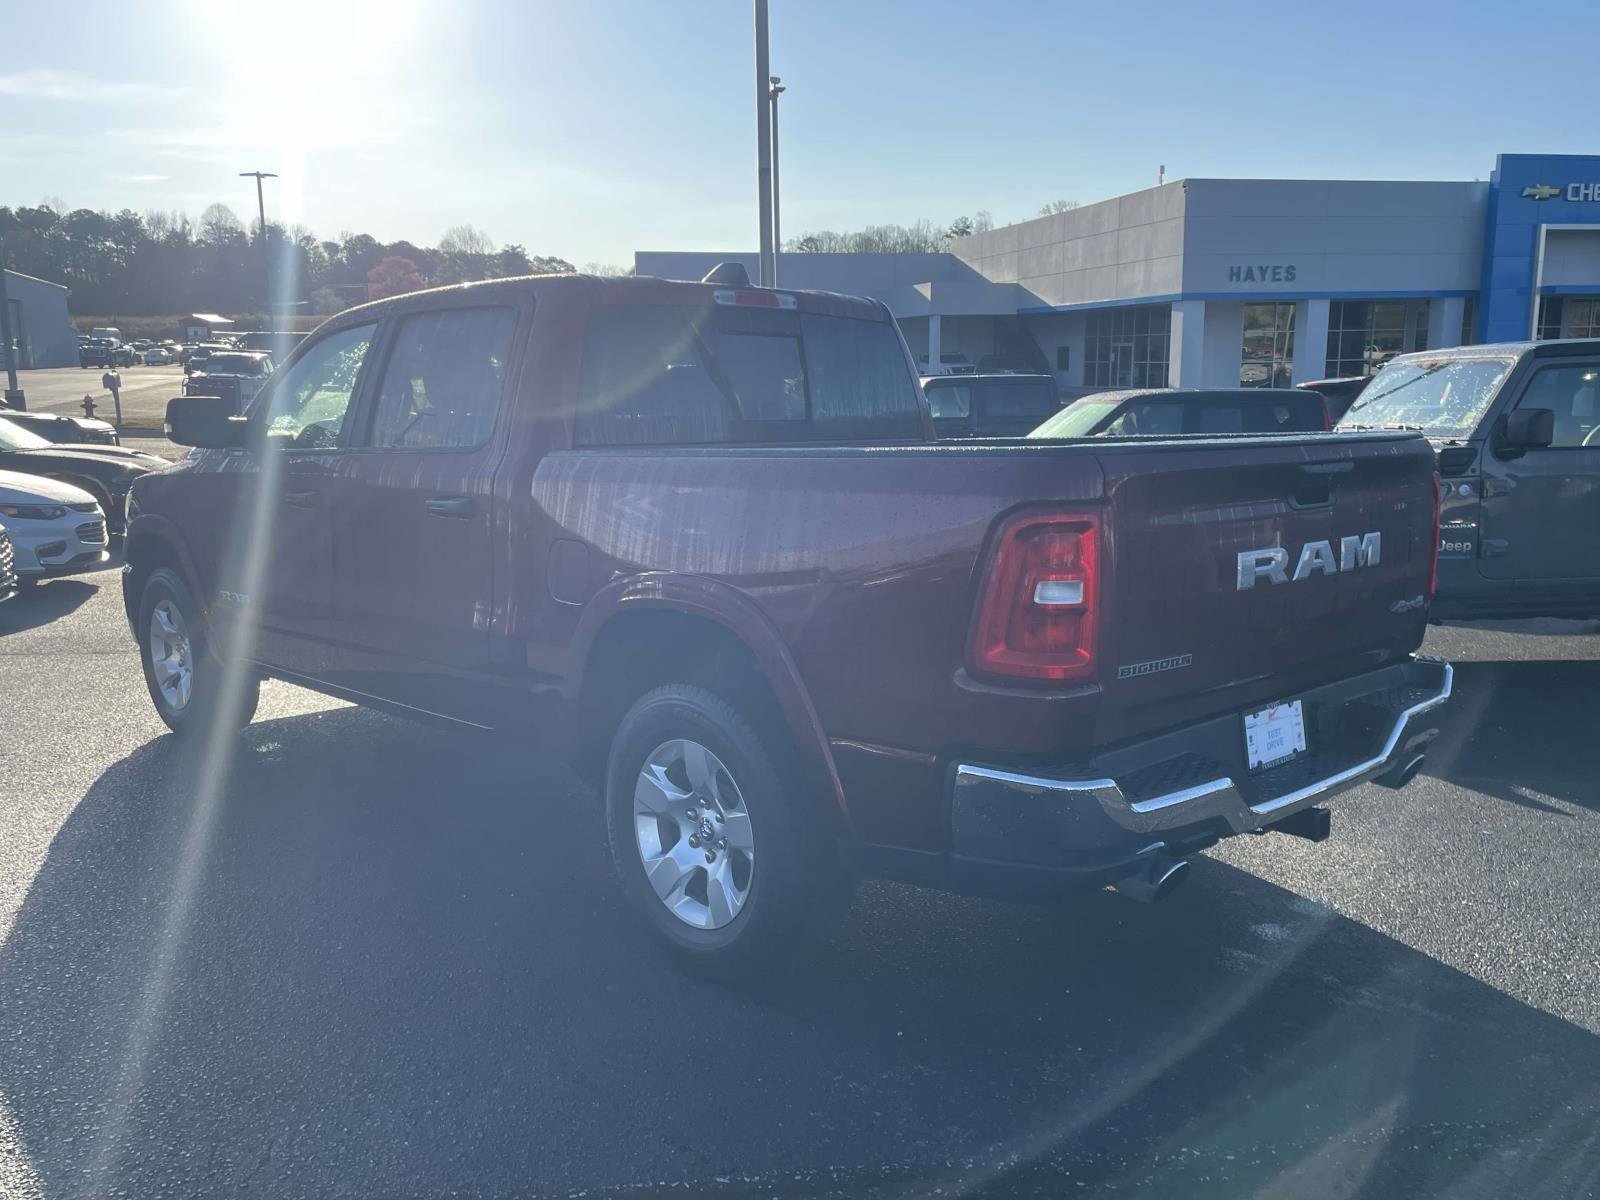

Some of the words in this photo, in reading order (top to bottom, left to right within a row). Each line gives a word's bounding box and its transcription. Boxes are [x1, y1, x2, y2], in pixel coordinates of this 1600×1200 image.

[1229, 265, 1297, 283] HAYES
[1438, 540, 1473, 554] Jeep
[1237, 532, 1381, 592] RAM
[1117, 654, 1193, 680] BIGHORN
